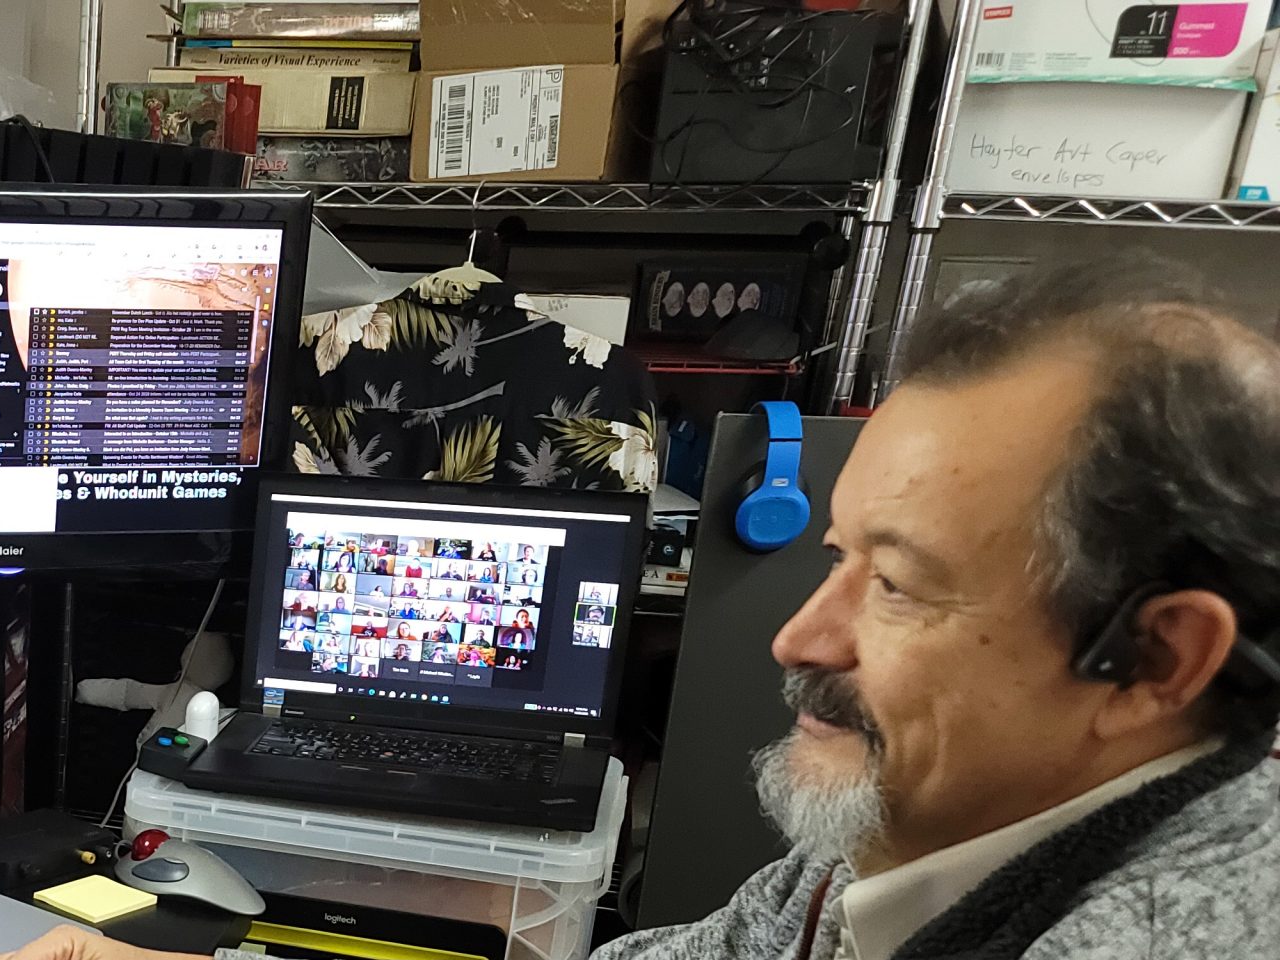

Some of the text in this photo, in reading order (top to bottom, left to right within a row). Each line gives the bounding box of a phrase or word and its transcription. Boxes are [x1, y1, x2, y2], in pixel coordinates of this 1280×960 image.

[219, 52, 361, 67] Varieties of Visual Experience
[1054, 137, 1091, 163] Art
[73, 470, 139, 485] Yourself
[142, 471, 156, 483] in
[161, 470, 242, 486] Mysteries,
[77, 487, 90, 499] &
[95, 486, 168, 499] Whodunit
[172, 486, 227, 498] Games
[324, 912, 357, 925] logitech
